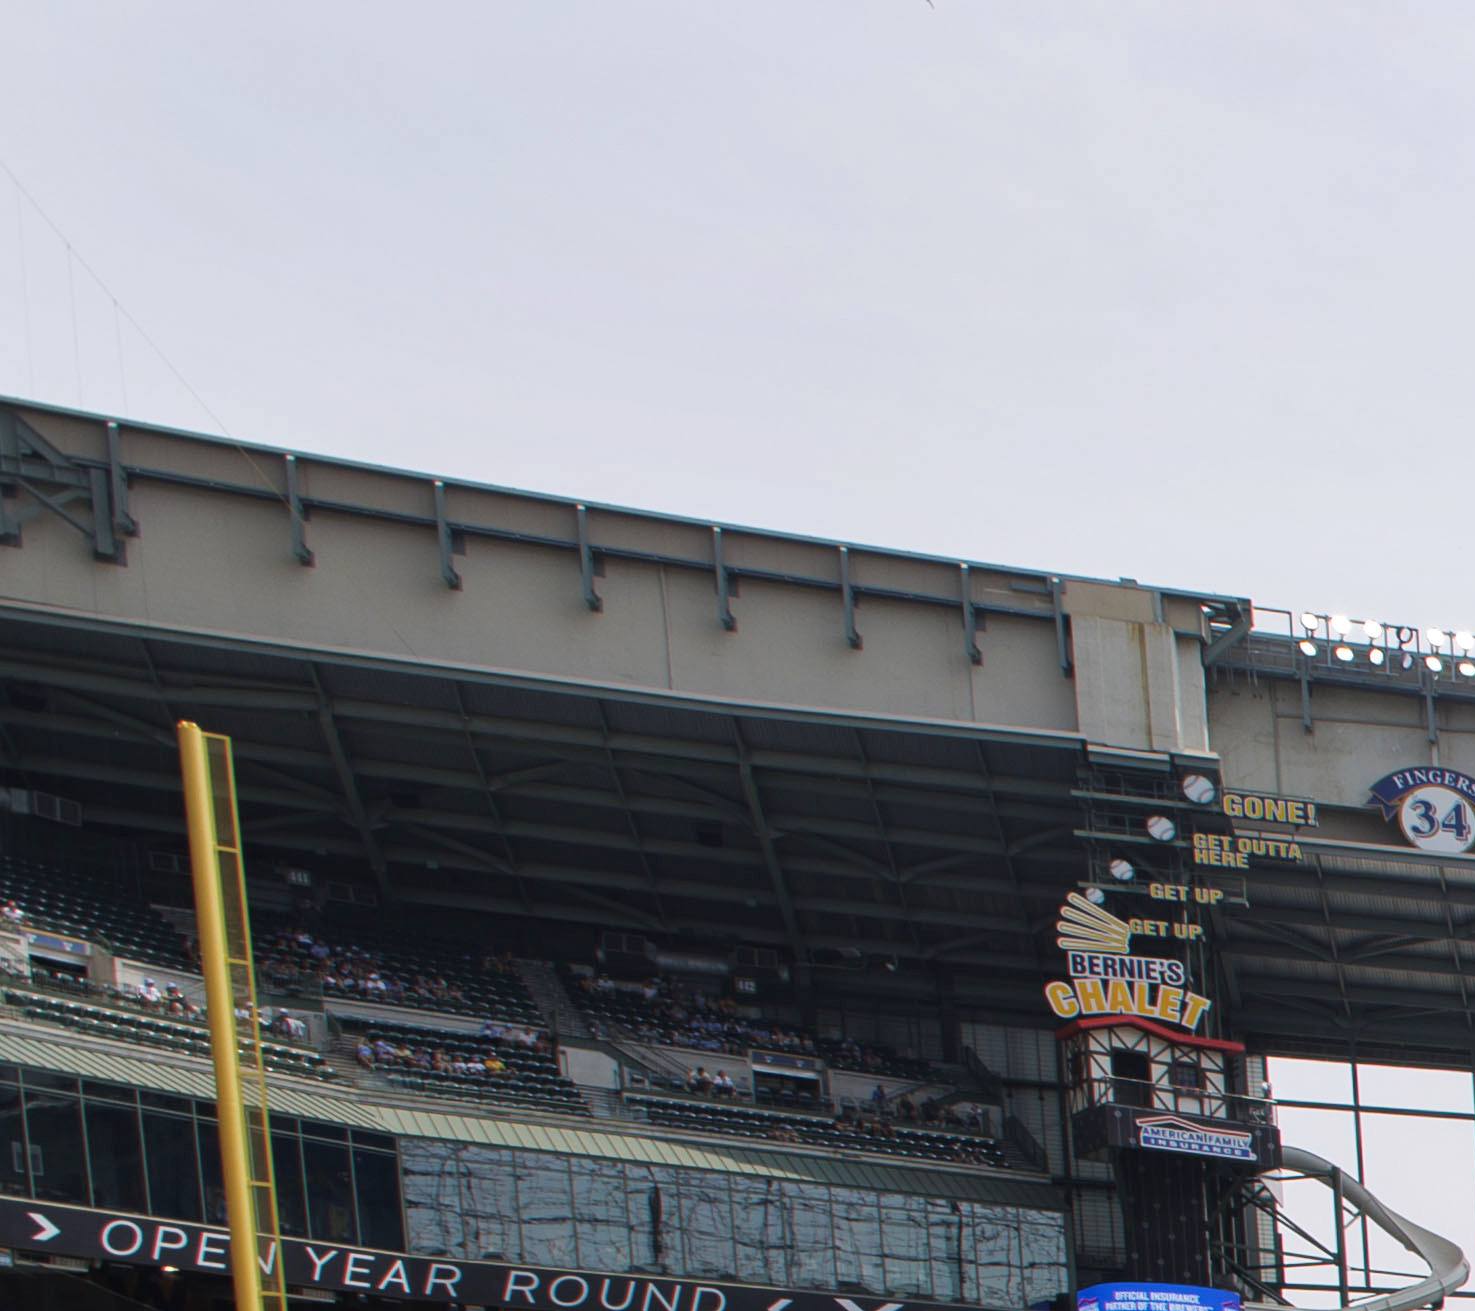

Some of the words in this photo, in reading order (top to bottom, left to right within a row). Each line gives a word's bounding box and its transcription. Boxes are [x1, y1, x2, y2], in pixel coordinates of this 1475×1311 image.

[1222, 793, 1318, 828] GONE!
[1409, 799, 1471, 841] 34
[1193, 833, 1232, 853] GET
[1238, 837, 1303, 860] OUTTA
[1194, 849, 1249, 869] HERE
[1149, 882, 1188, 902] GET
[1195, 886, 1224, 905] UP
[1128, 918, 1168, 938] GET
[1174, 922, 1202, 941] UP
[1069, 951, 1186, 985] BERNIE'S
[1045, 979, 1211, 1030] CHALET
[1142, 1126, 1204, 1143] AMERICAN
[304, 1244, 463, 1299] YEAR
